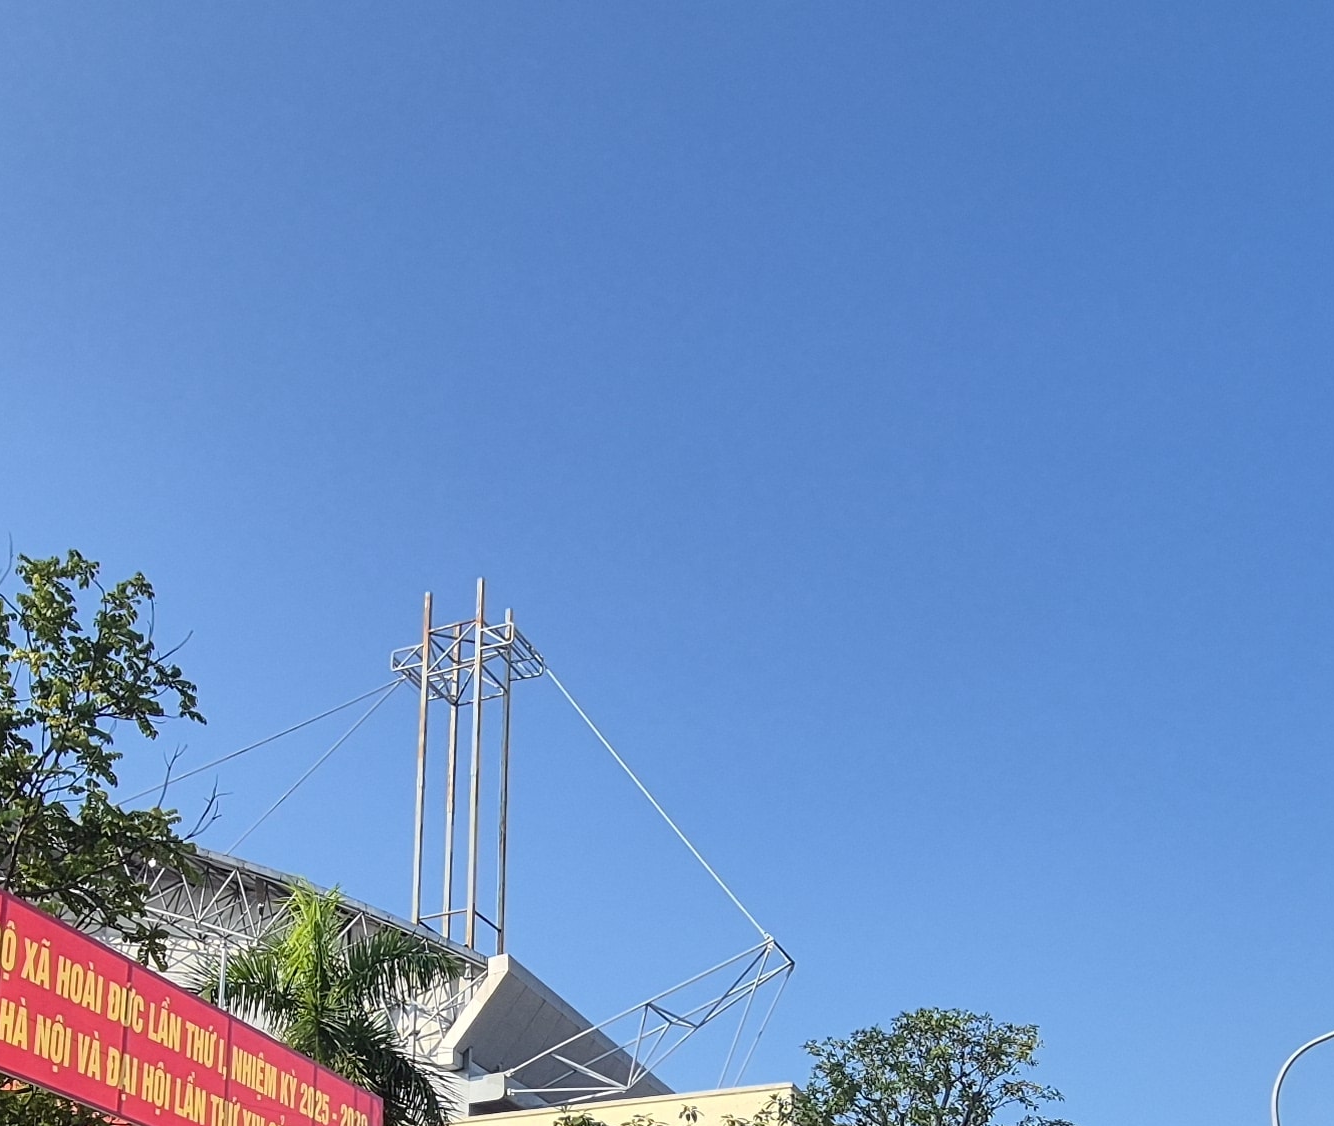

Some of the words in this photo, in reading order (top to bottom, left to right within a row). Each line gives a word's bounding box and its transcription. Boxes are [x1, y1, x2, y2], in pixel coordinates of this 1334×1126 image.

[20, 937, 51, 991] XÃ
[55, 955, 104, 1015] HOÀI
[106, 980, 145, 1035] ĐỨC
[147, 996, 182, 1053] LẦN
[185, 1020, 218, 1069] THỨ
[217, 1038, 228, 1081] I,
[230, 1046, 278, 1101] NHIỆM
[279, 1069, 298, 1110] KỲ
[299, 1082, 331, 1126] 2025
[33, 1013, 72, 1073] NỘI
[77, 1030, 102, 1081] VÀ
[106, 1045, 139, 1101] ĐẠI
[140, 1061, 172, 1116] HỘI
[173, 1070, 207, 1126] LẦN
